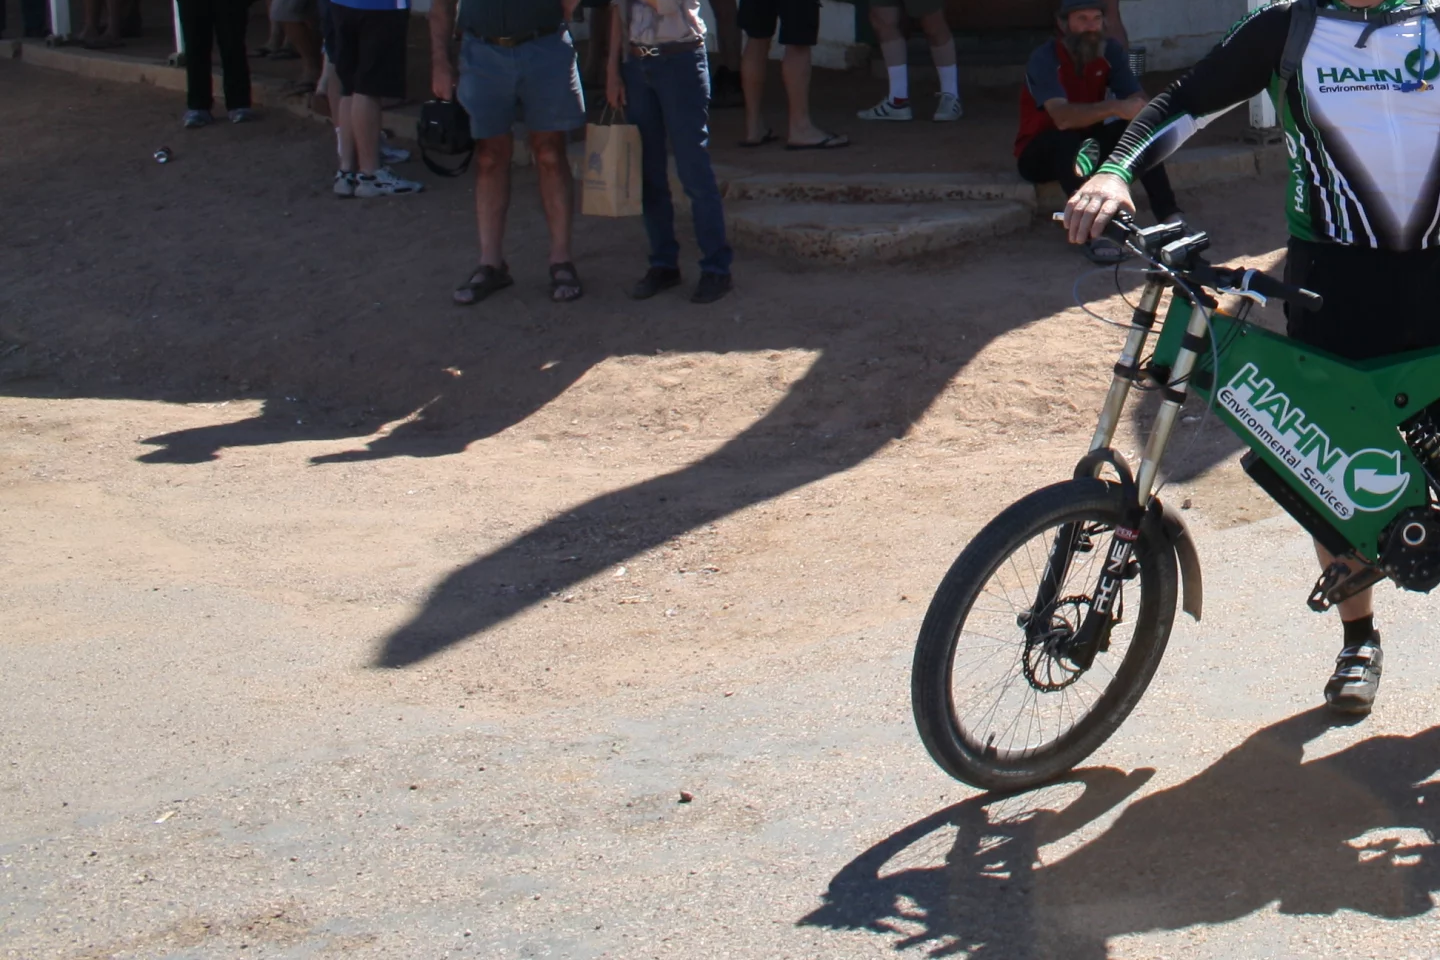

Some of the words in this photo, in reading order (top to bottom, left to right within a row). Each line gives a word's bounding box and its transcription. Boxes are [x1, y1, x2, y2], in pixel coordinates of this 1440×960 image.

[1316, 67, 1403, 84] HAHN
[1319, 83, 1390, 93] Environmental
[1229, 364, 1344, 476] HAHN
[1219, 389, 1301, 469] Environmental
[1300, 467, 1349, 518] Services
